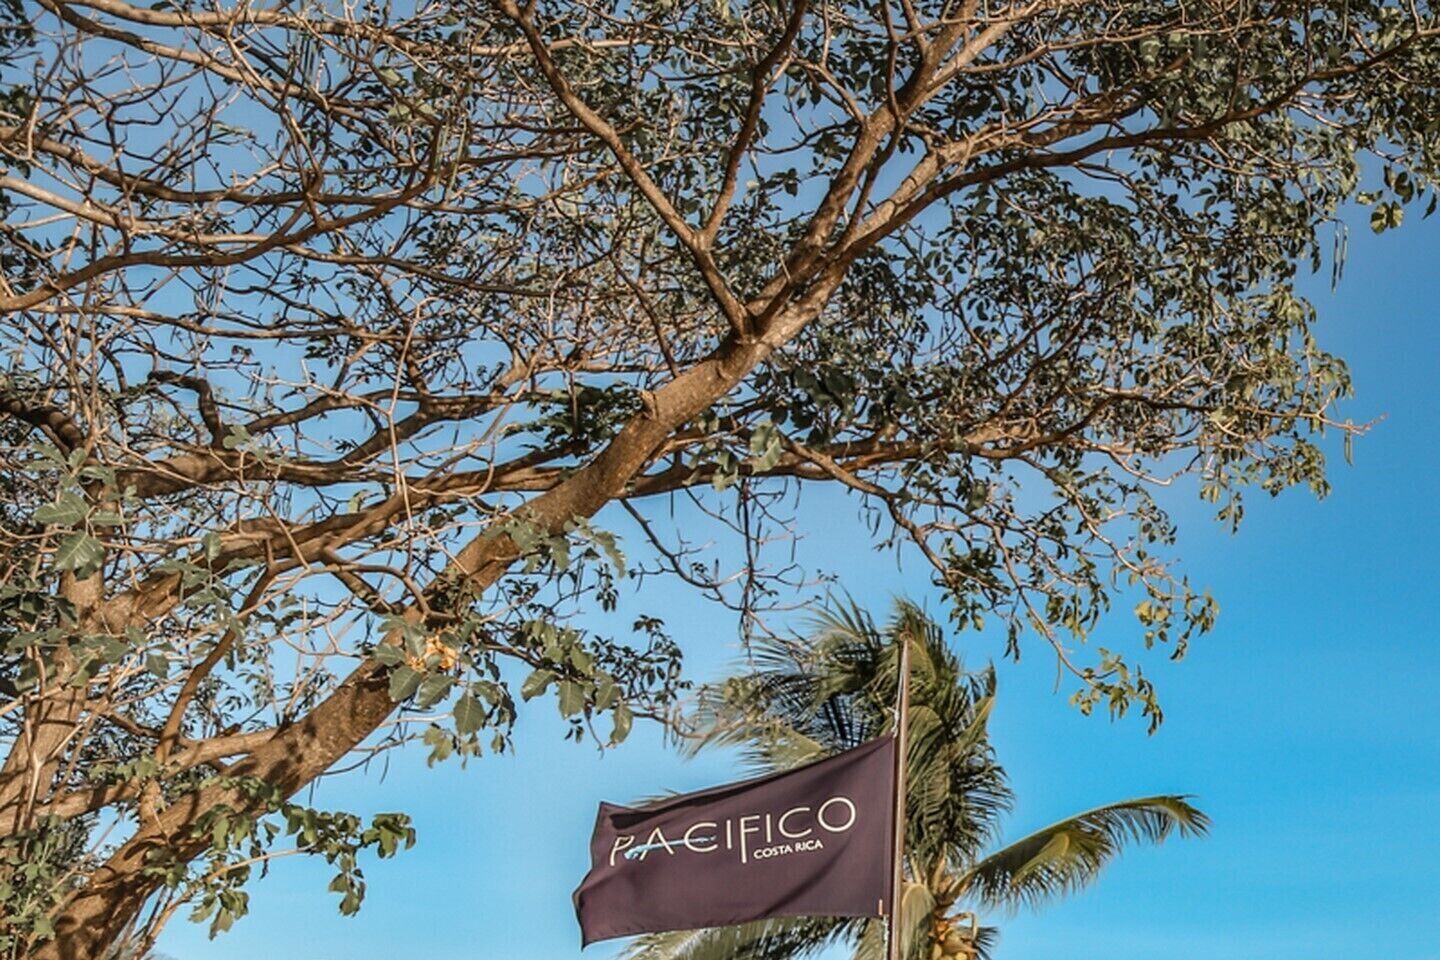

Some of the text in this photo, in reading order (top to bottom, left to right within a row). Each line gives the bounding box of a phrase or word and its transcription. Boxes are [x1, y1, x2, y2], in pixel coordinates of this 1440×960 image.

[609, 797, 856, 867] PACIFICO
[753, 839, 824, 860] COSTA RICA
